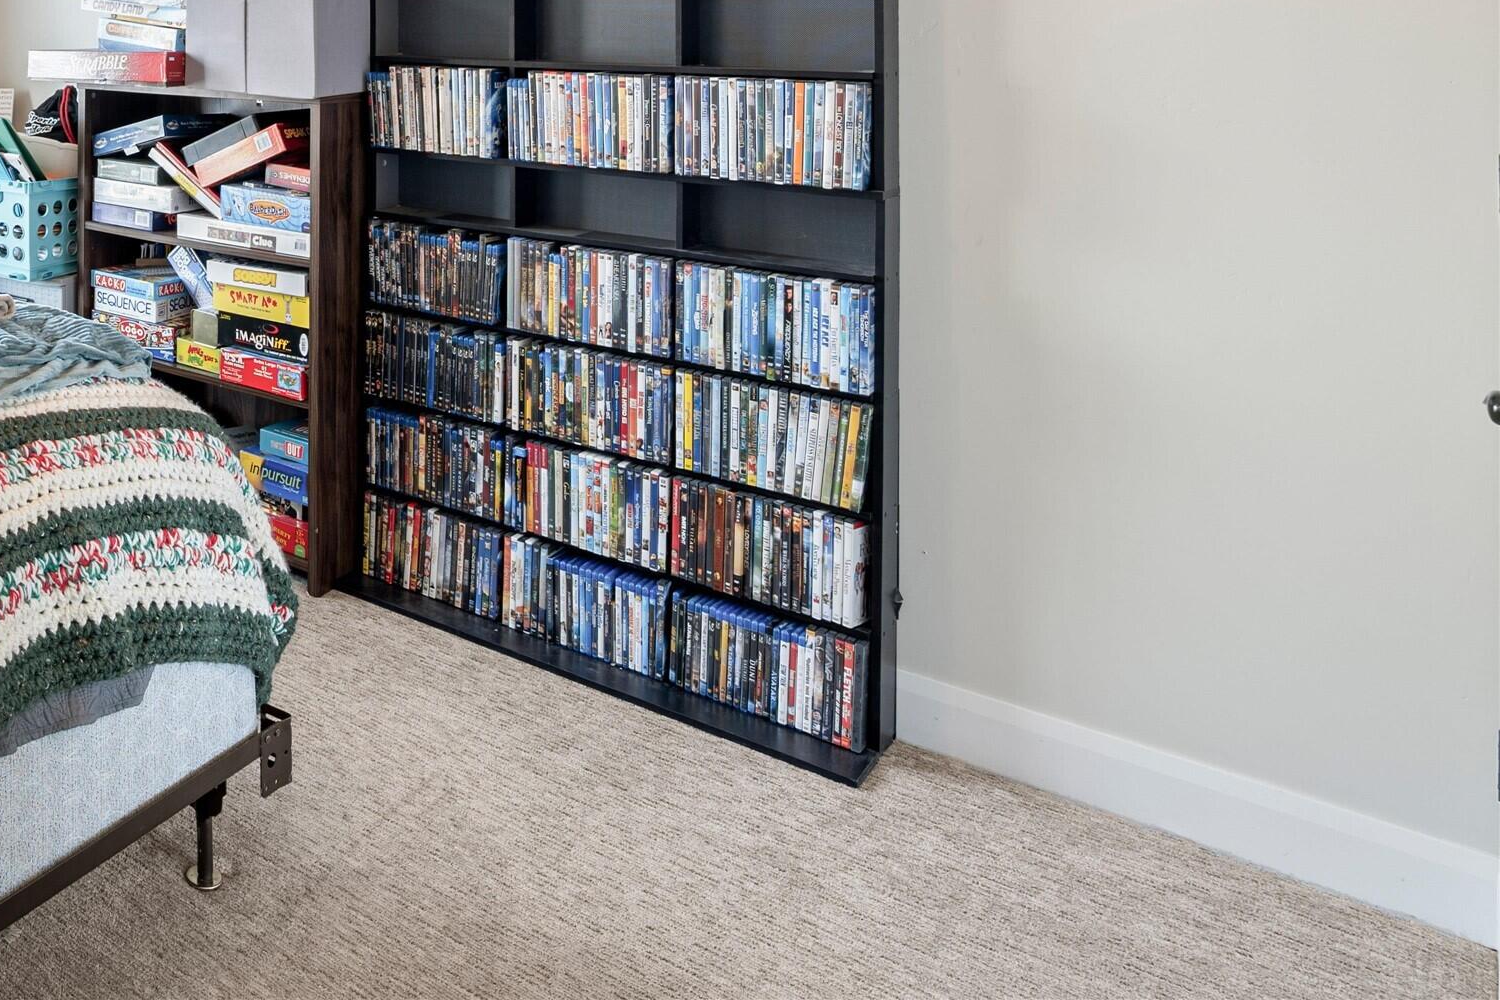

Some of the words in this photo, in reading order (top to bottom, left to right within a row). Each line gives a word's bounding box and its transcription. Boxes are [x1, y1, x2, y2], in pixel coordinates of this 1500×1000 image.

[121, 1, 144, 15] LAND
[279, 171, 310, 185] DENAMES
[252, 235, 275, 248] Clue
[97, 290, 152, 315] SEQUENCE
[230, 290, 259, 305] SMART
[120, 324, 144, 336] LOGO
[286, 442, 302, 458] OUT
[260, 466, 302, 490] pursuit
[825, 654, 833, 682] AVP
[842, 666, 852, 704] FLETCH
